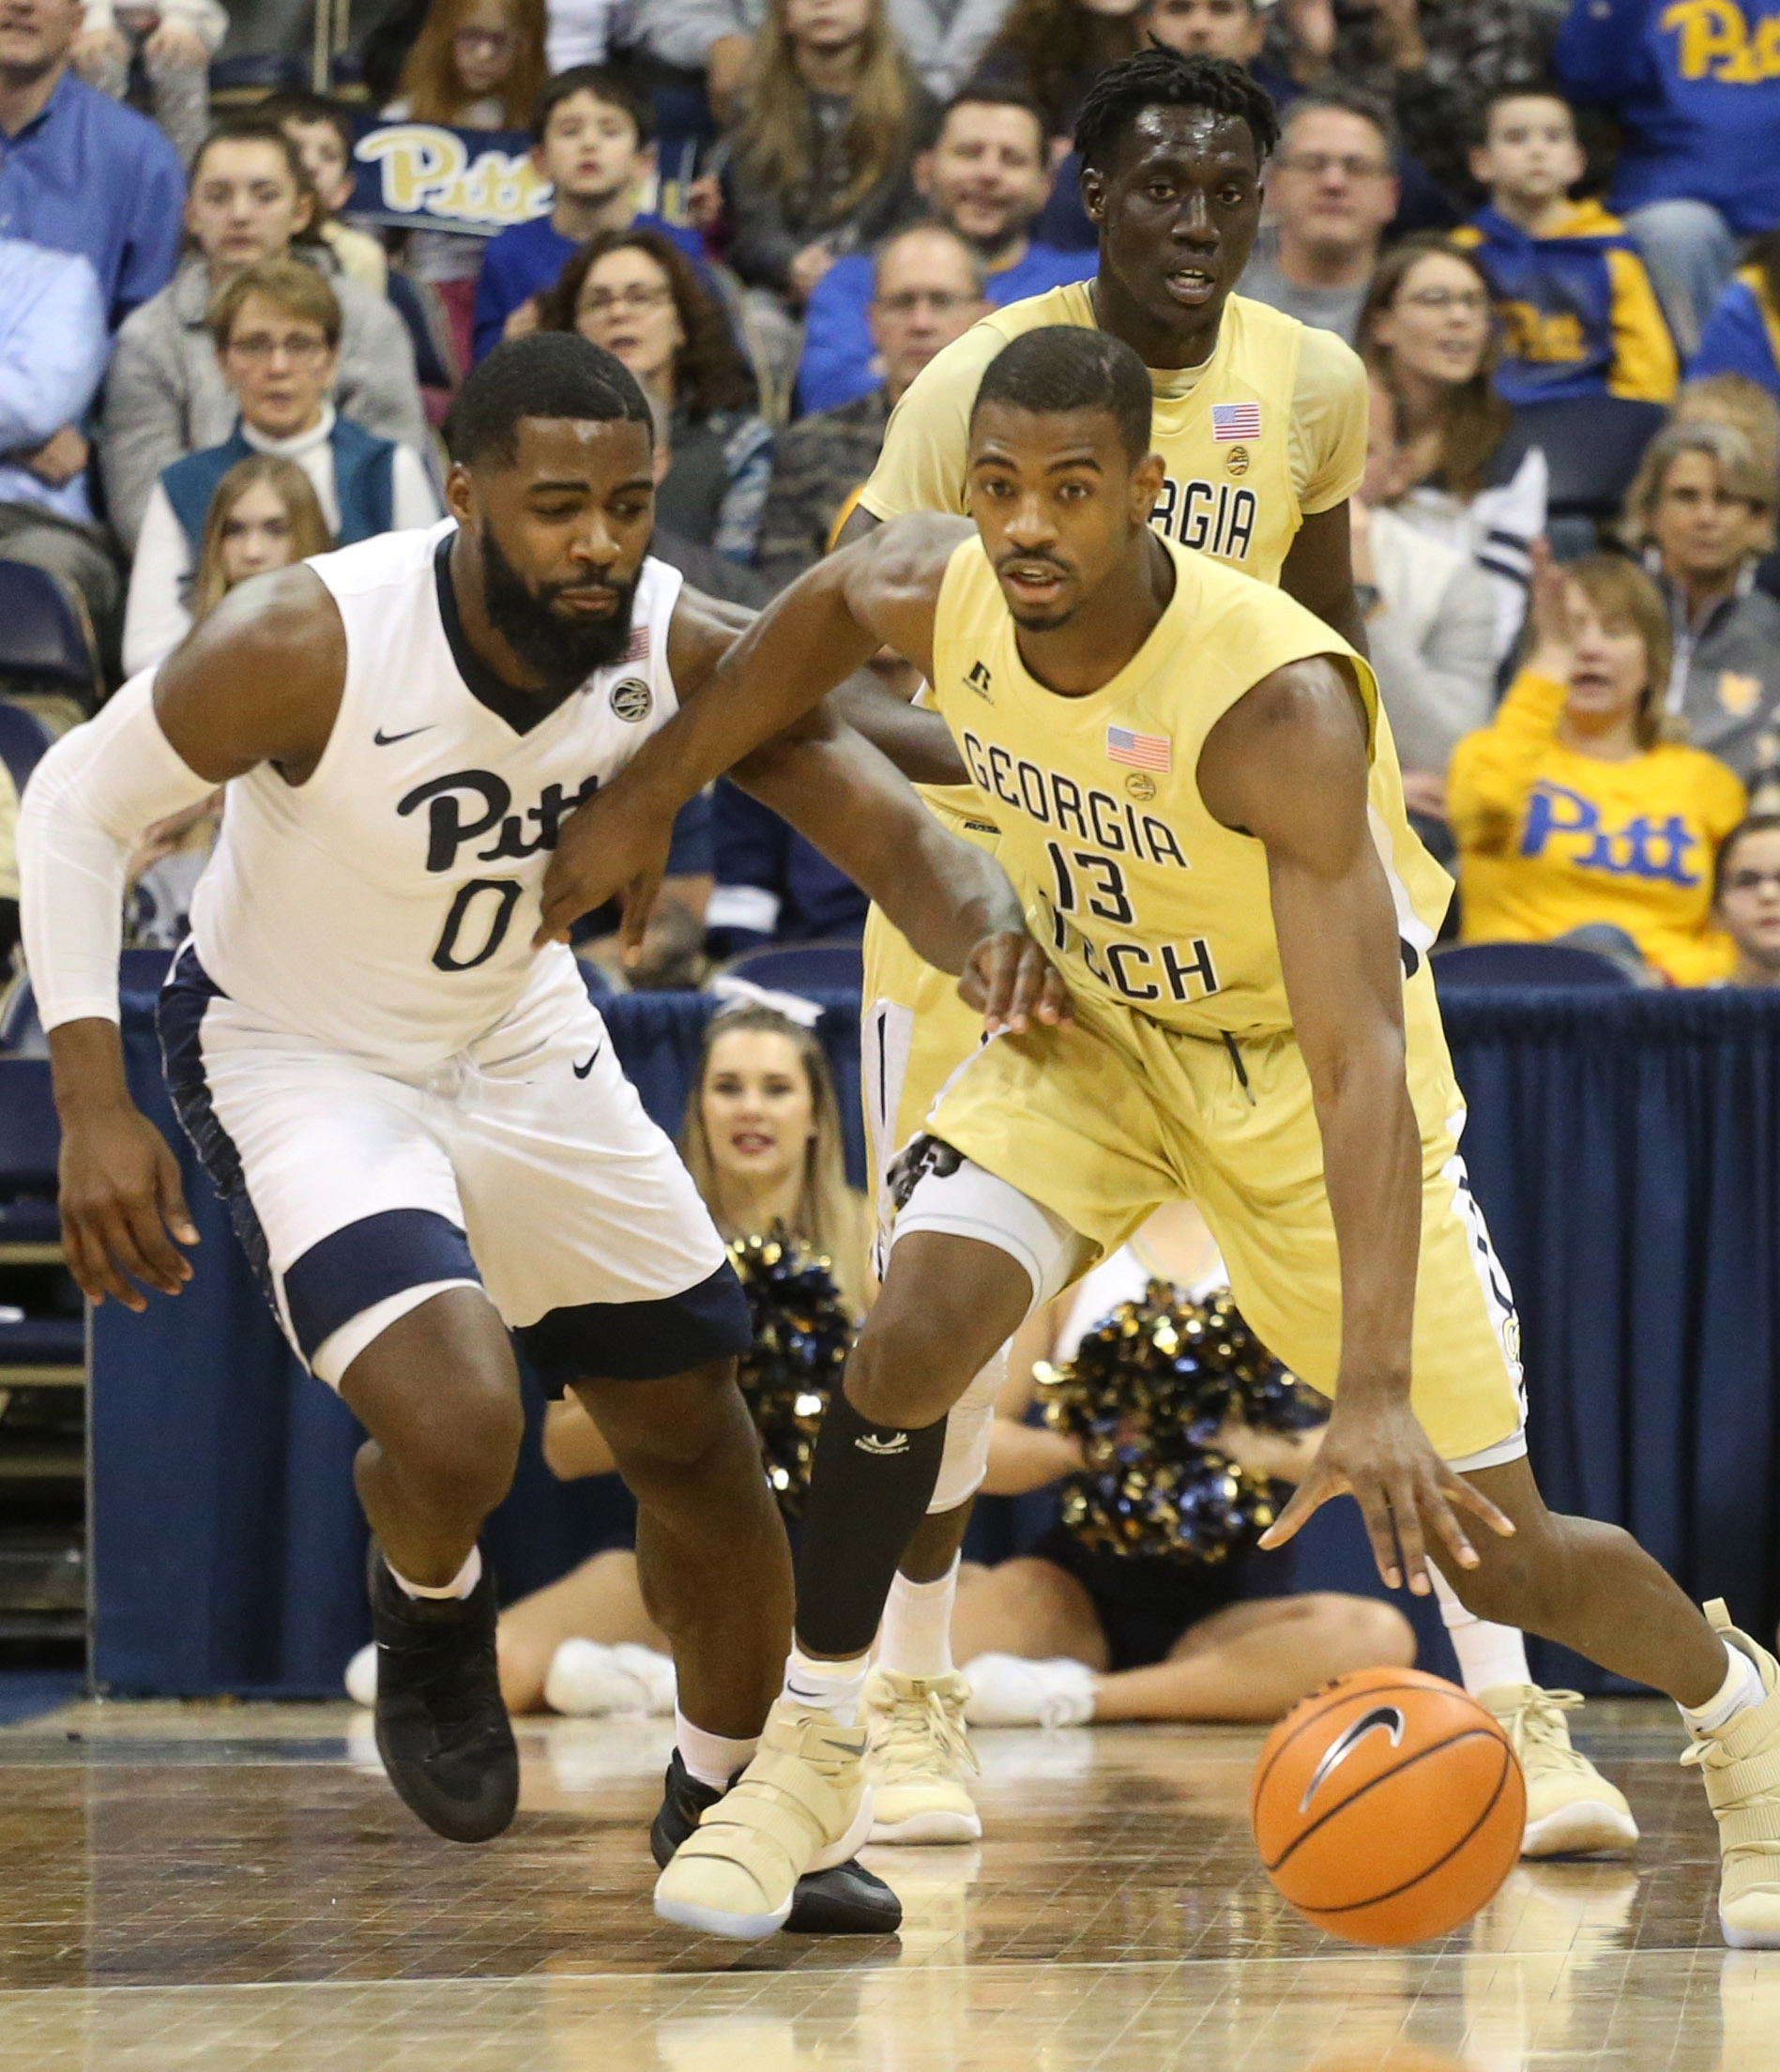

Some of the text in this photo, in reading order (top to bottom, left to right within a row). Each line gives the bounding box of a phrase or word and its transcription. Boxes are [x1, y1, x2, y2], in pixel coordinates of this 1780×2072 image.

[354, 123, 555, 226] Pitt
[963, 729, 1192, 870] GEORGIA
[1519, 778, 1700, 889] Pitt
[432, 877, 524, 972] 0
[1045, 840, 1136, 927] 13
